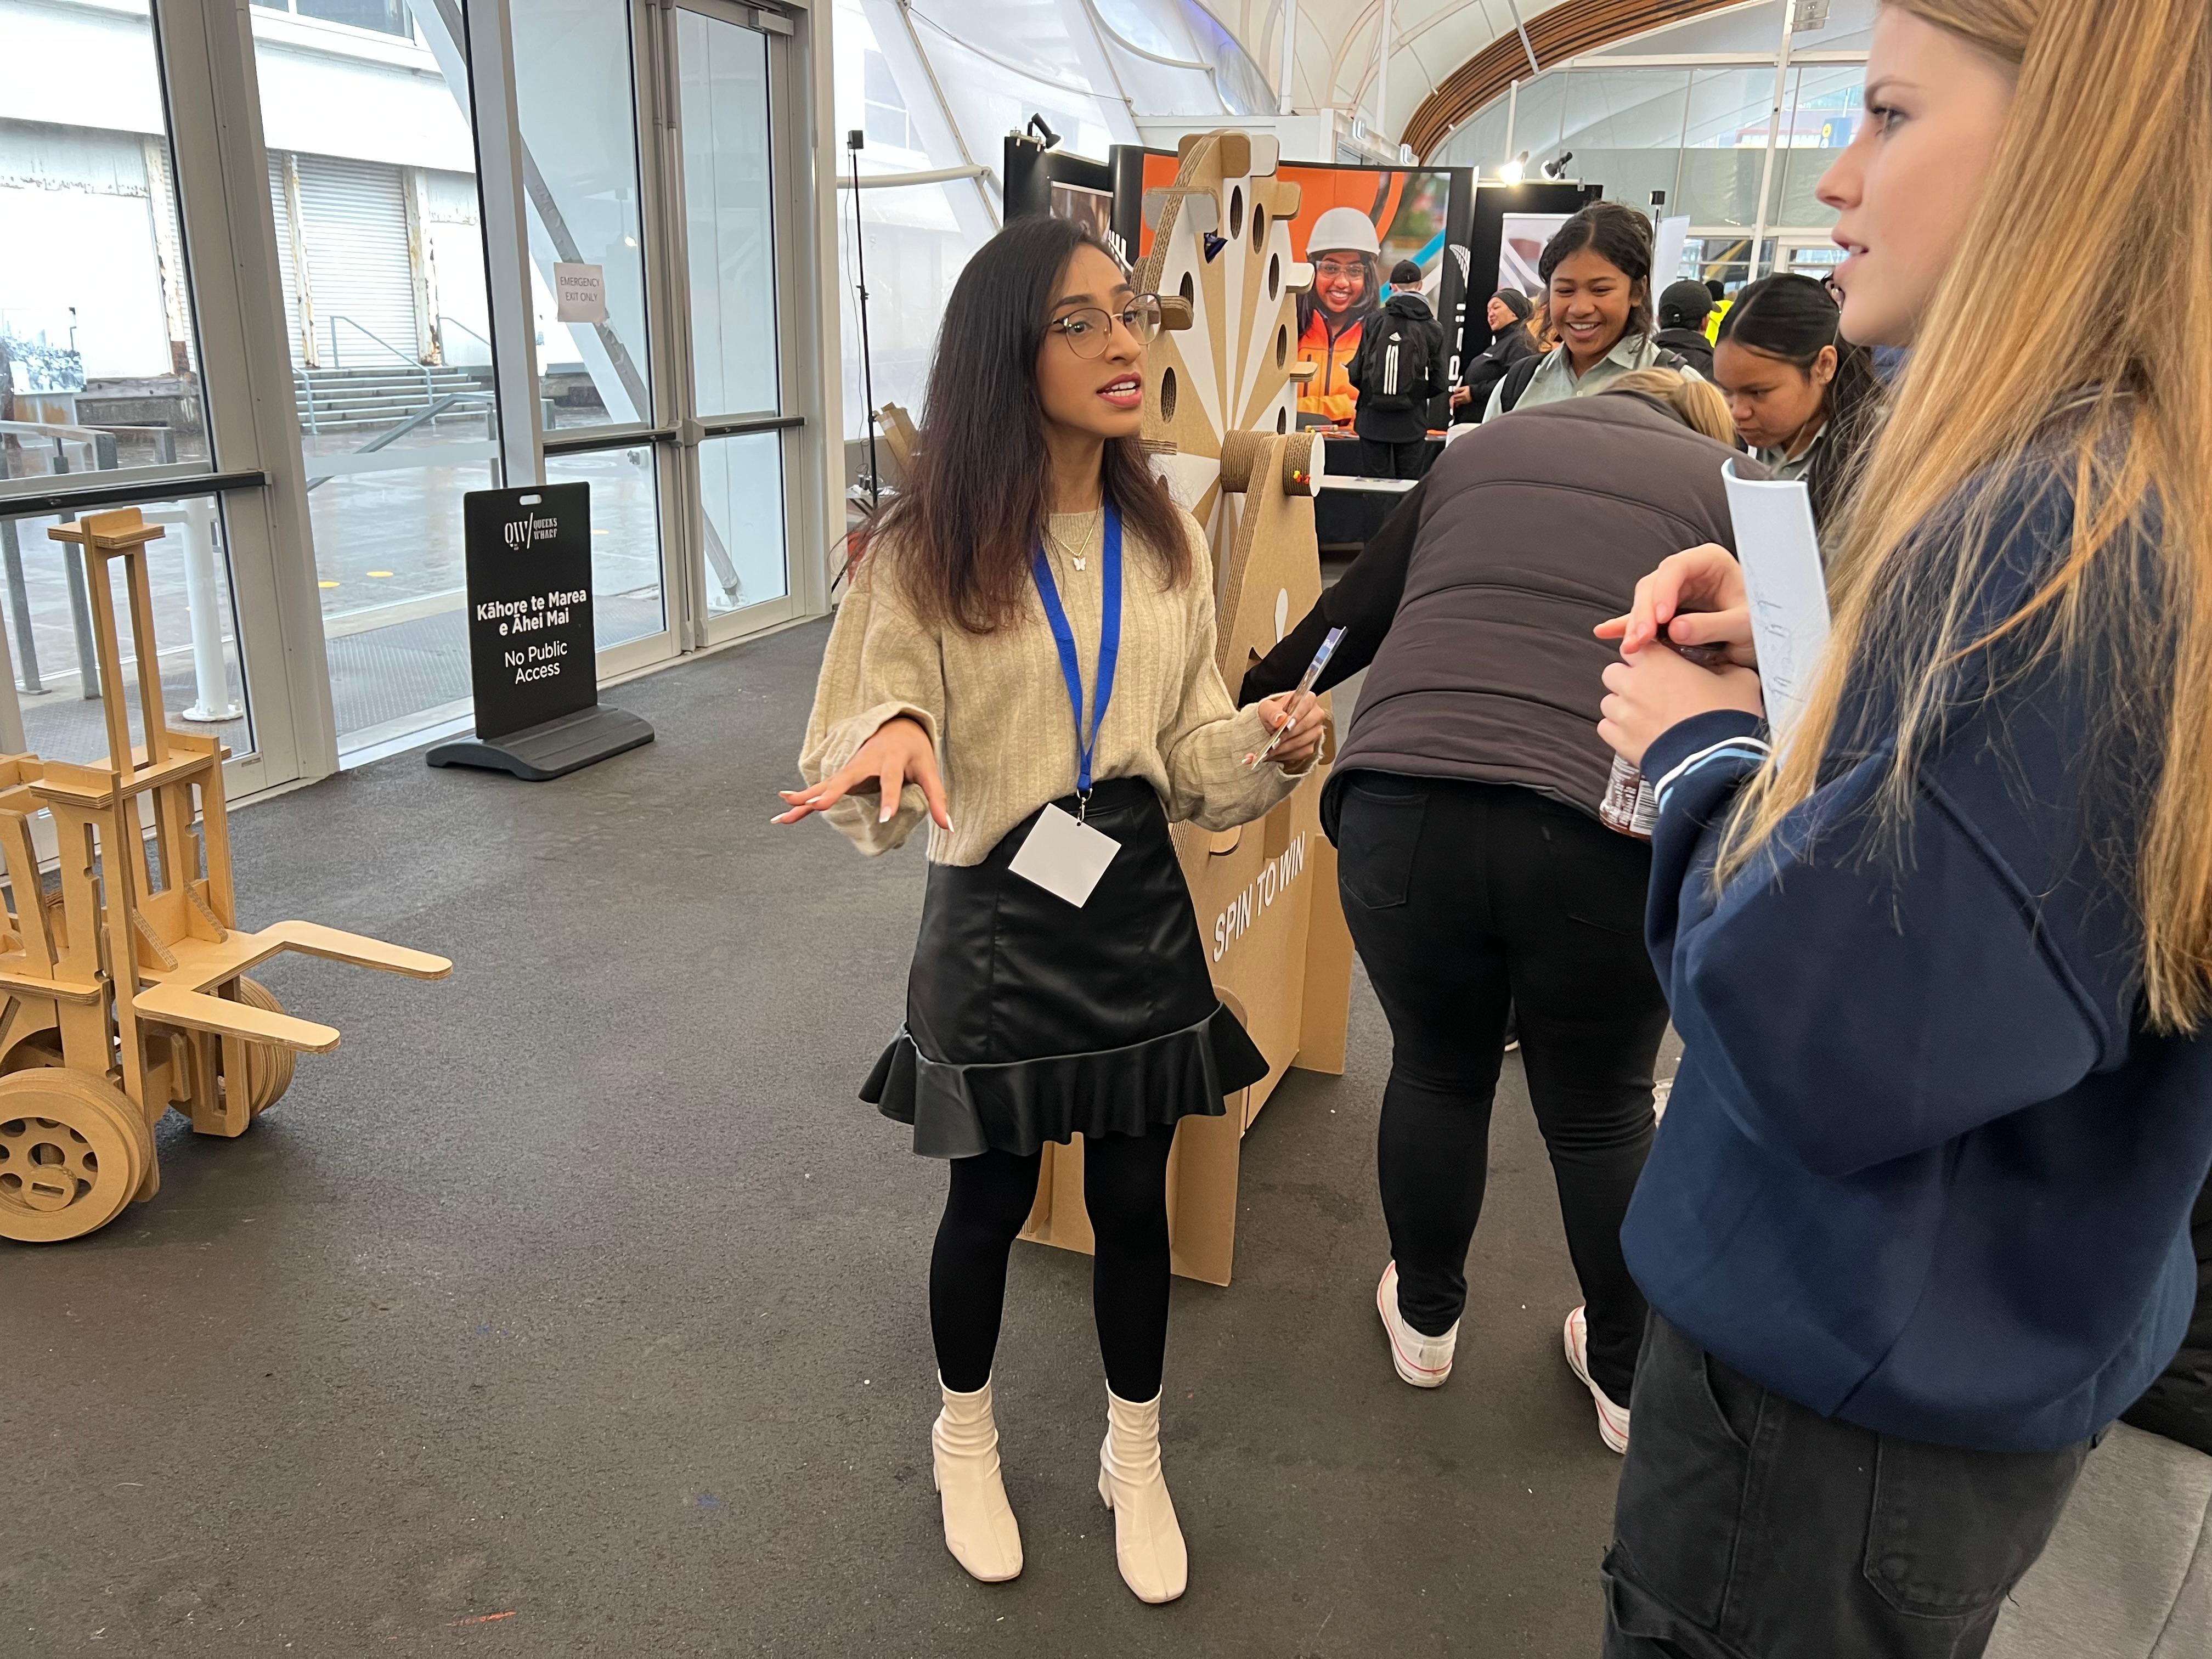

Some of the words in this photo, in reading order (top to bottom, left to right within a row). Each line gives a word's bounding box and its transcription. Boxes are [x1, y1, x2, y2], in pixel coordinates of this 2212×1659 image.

[560, 276, 600, 287] EMERGENCY
[566, 292, 579, 301] EXIT
[580, 292, 598, 302] ONLY
[477, 601, 528, 621] Kāhore
[531, 596, 545, 612] te
[549, 589, 587, 608] Marea
[499, 623, 509, 636] e
[512, 612, 543, 634] Āhei
[547, 607, 569, 627] Mai
[505, 651, 524, 668] No
[528, 641, 568, 662] Public
[515, 662, 561, 685] Access
[1213, 884, 1252, 962] SPIN
[1256, 862, 1277, 917] TO
[1279, 831, 1306, 893] WIN
